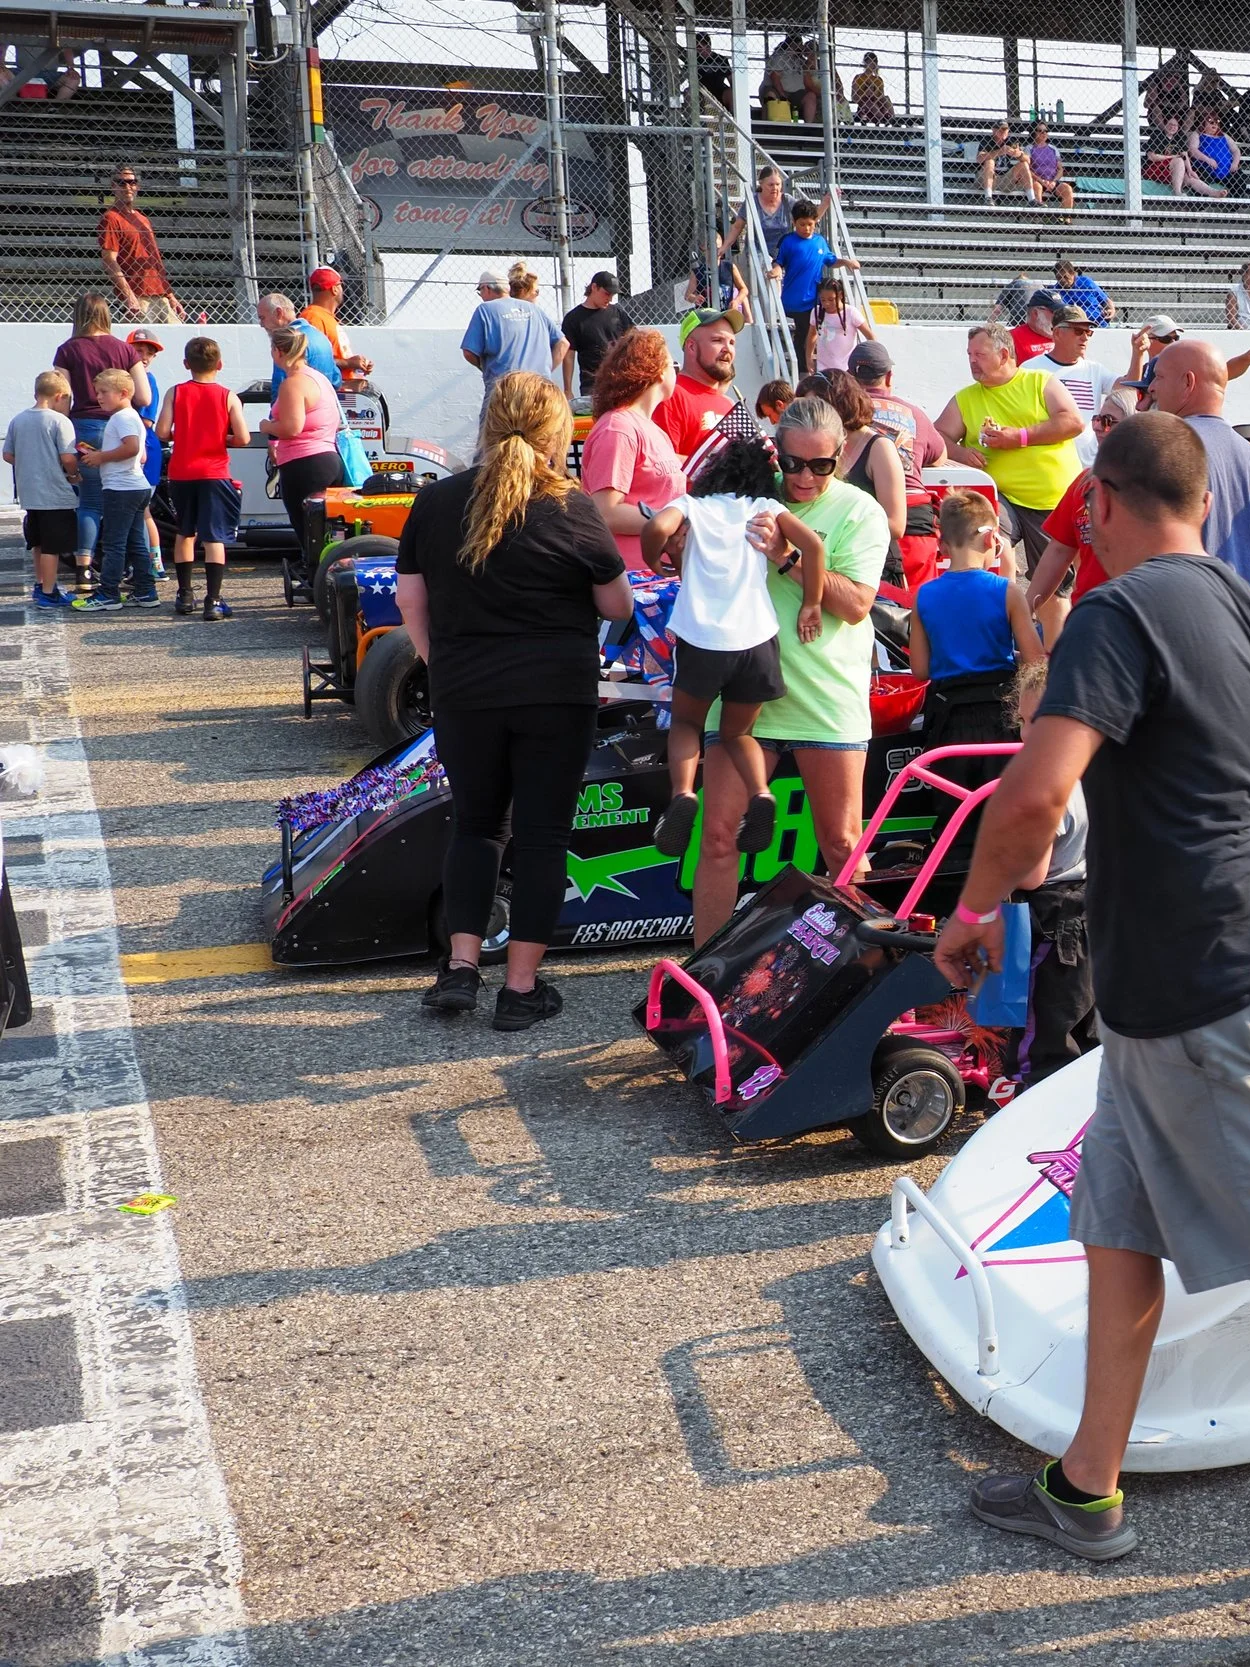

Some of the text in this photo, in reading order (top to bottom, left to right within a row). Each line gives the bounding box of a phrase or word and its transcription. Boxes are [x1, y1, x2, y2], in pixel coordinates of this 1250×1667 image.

[360, 98, 538, 141] Thank You
[351, 148, 549, 190] for attending
[393, 199, 516, 233] tonigt!
[654, 459, 680, 476] SILVE
[571, 807, 651, 831] EMENT
[570, 922, 608, 945] F&S
[605, 916, 683, 943] RACECAR
[737, 1064, 781, 1100] 12
